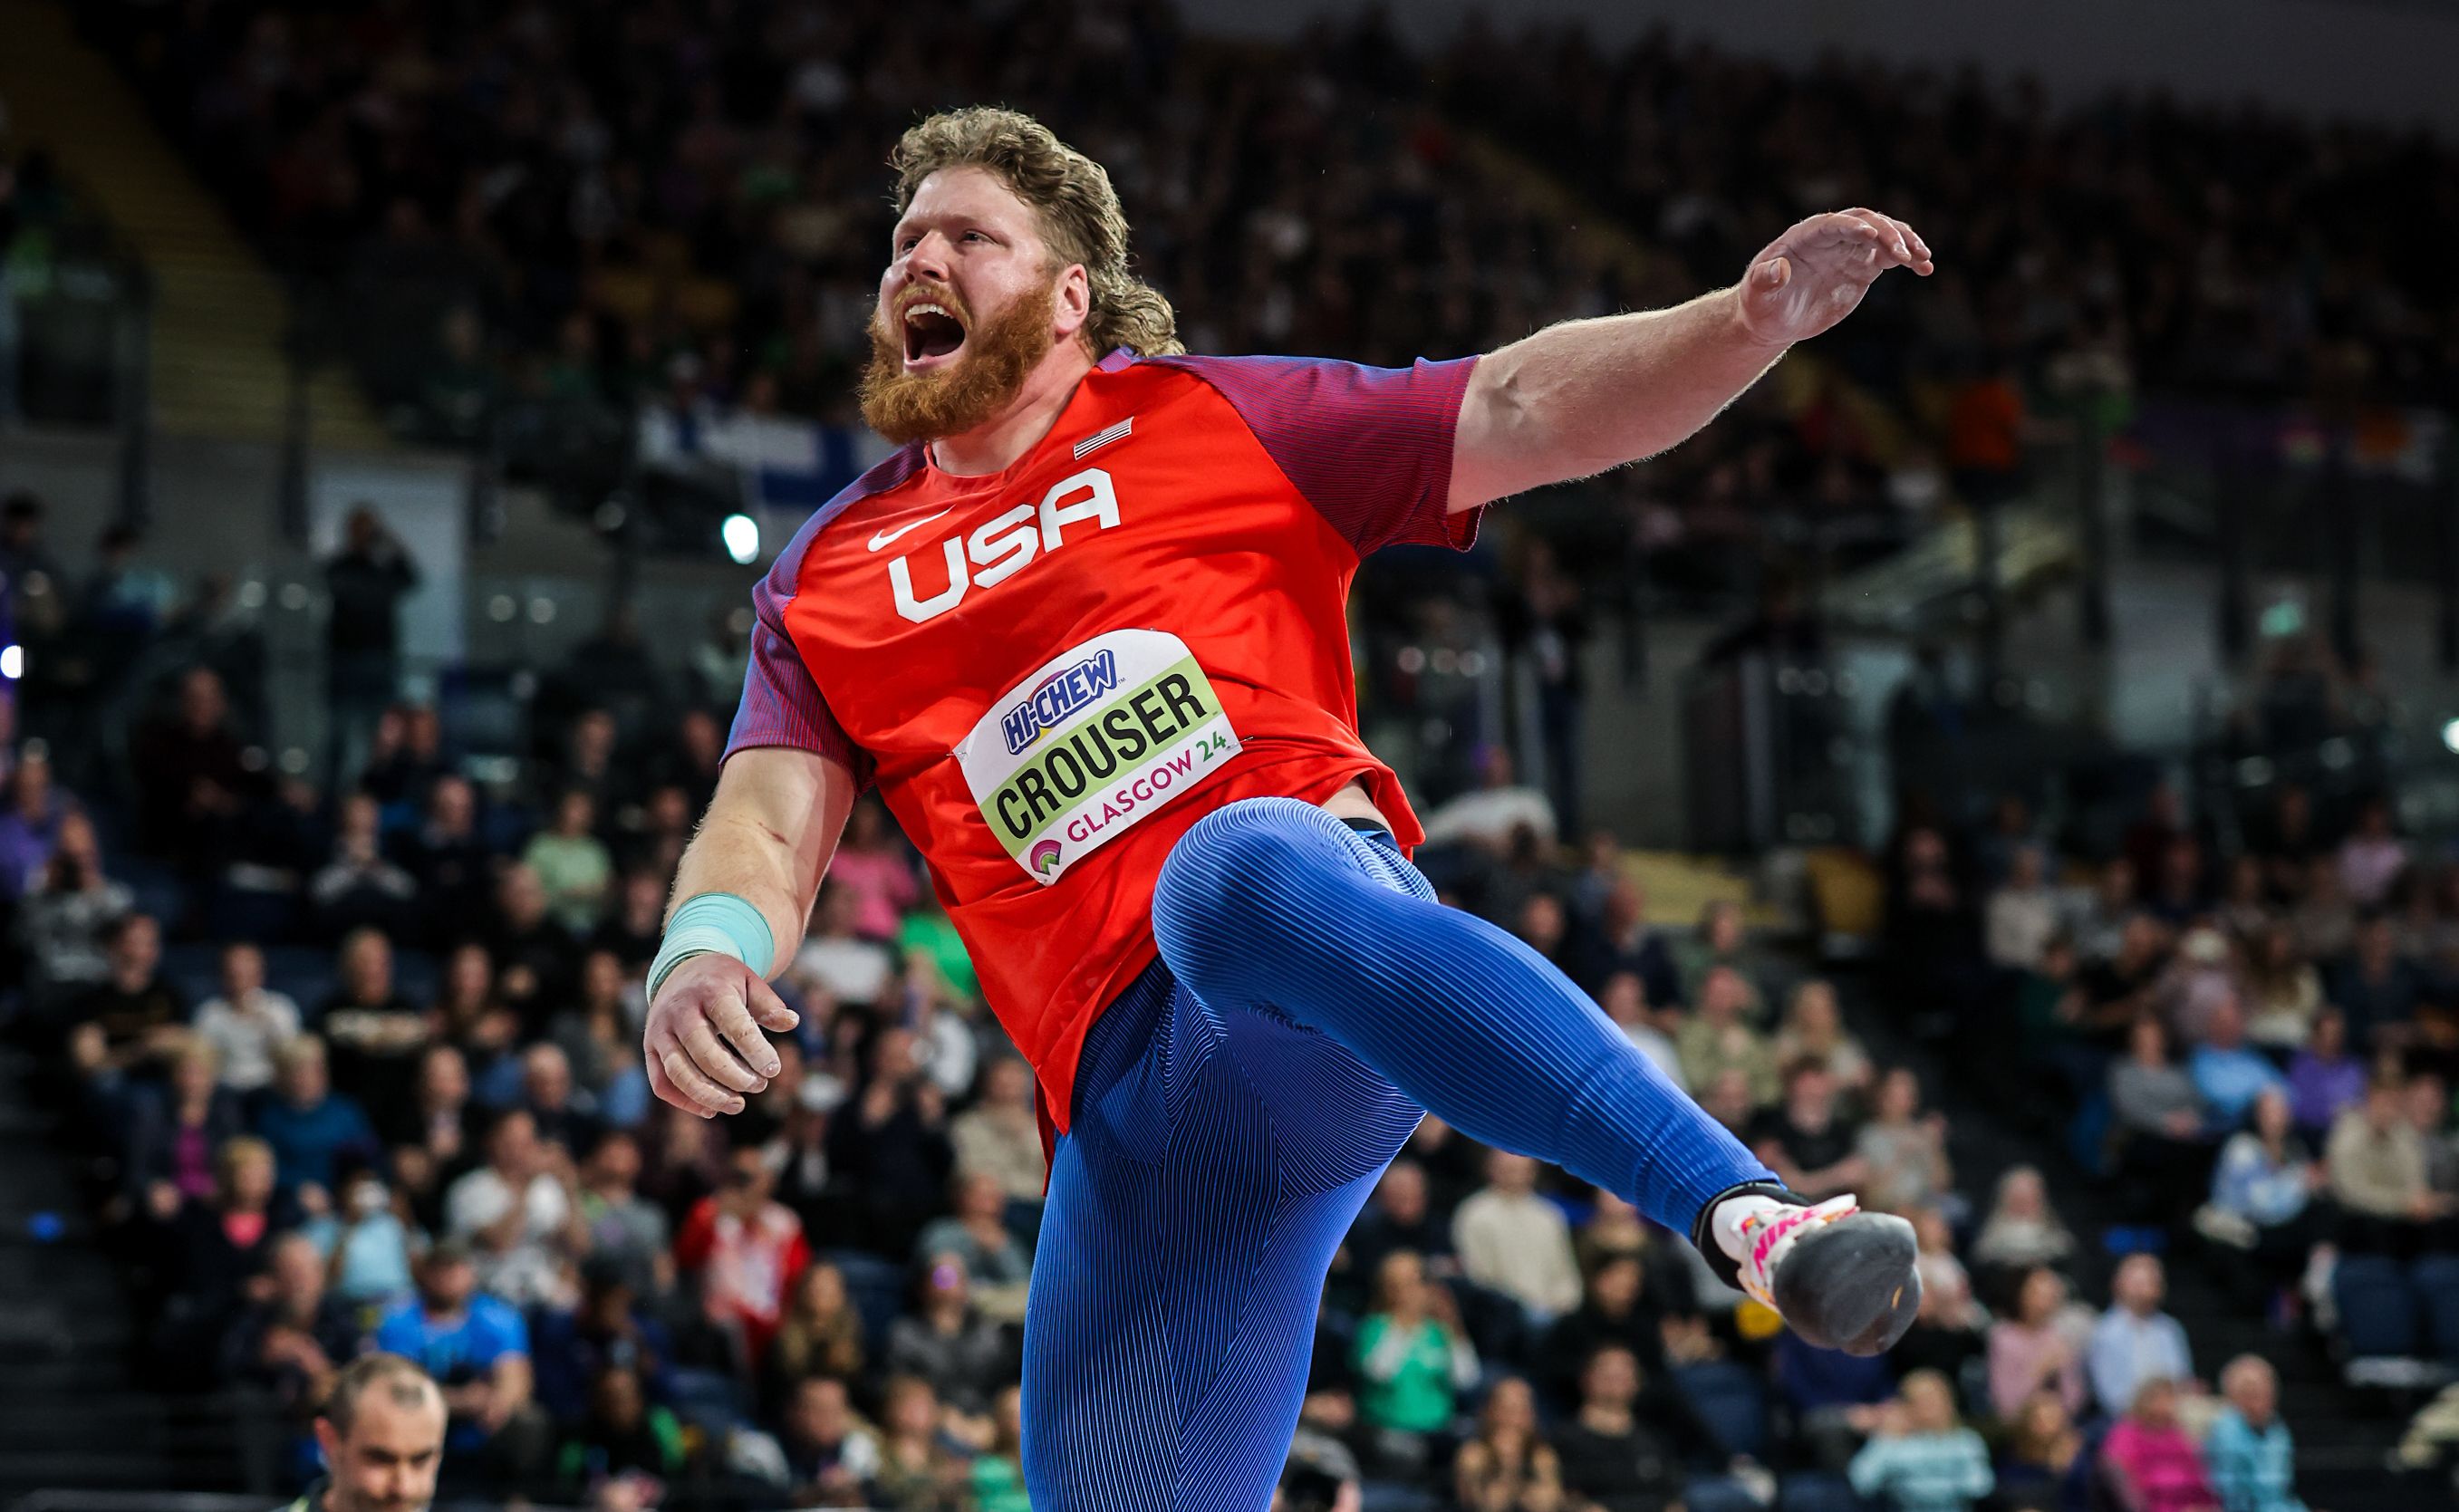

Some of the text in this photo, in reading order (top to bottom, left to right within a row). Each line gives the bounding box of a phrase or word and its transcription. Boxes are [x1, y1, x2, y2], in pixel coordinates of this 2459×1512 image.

[888, 467, 1121, 623] USA
[997, 673, 1207, 839] CROUSER
[1001, 650, 1117, 755] HI-CHEW
[1067, 731, 1227, 842] GLASGOW 24
